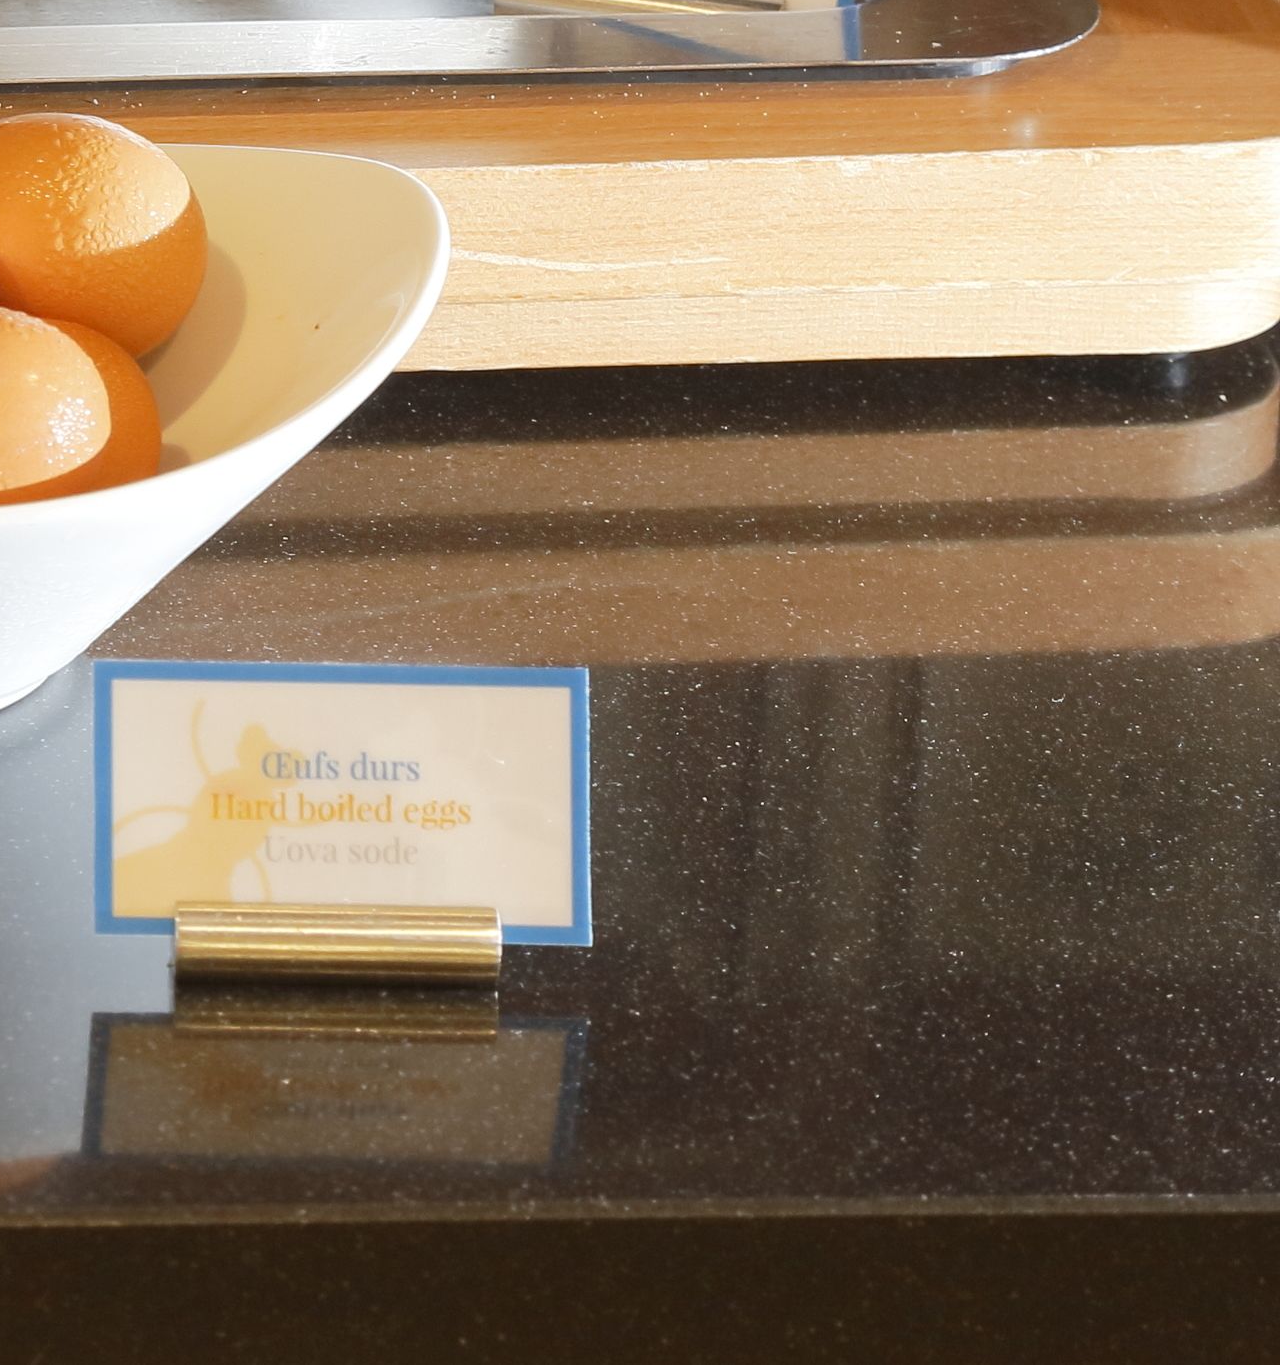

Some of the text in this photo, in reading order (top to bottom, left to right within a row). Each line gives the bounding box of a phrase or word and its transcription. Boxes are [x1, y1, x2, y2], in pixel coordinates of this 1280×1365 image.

[261, 750, 421, 781] Œufs durs
[209, 792, 472, 830] Hard boiled eggs
[263, 836, 418, 865] Uova sode
